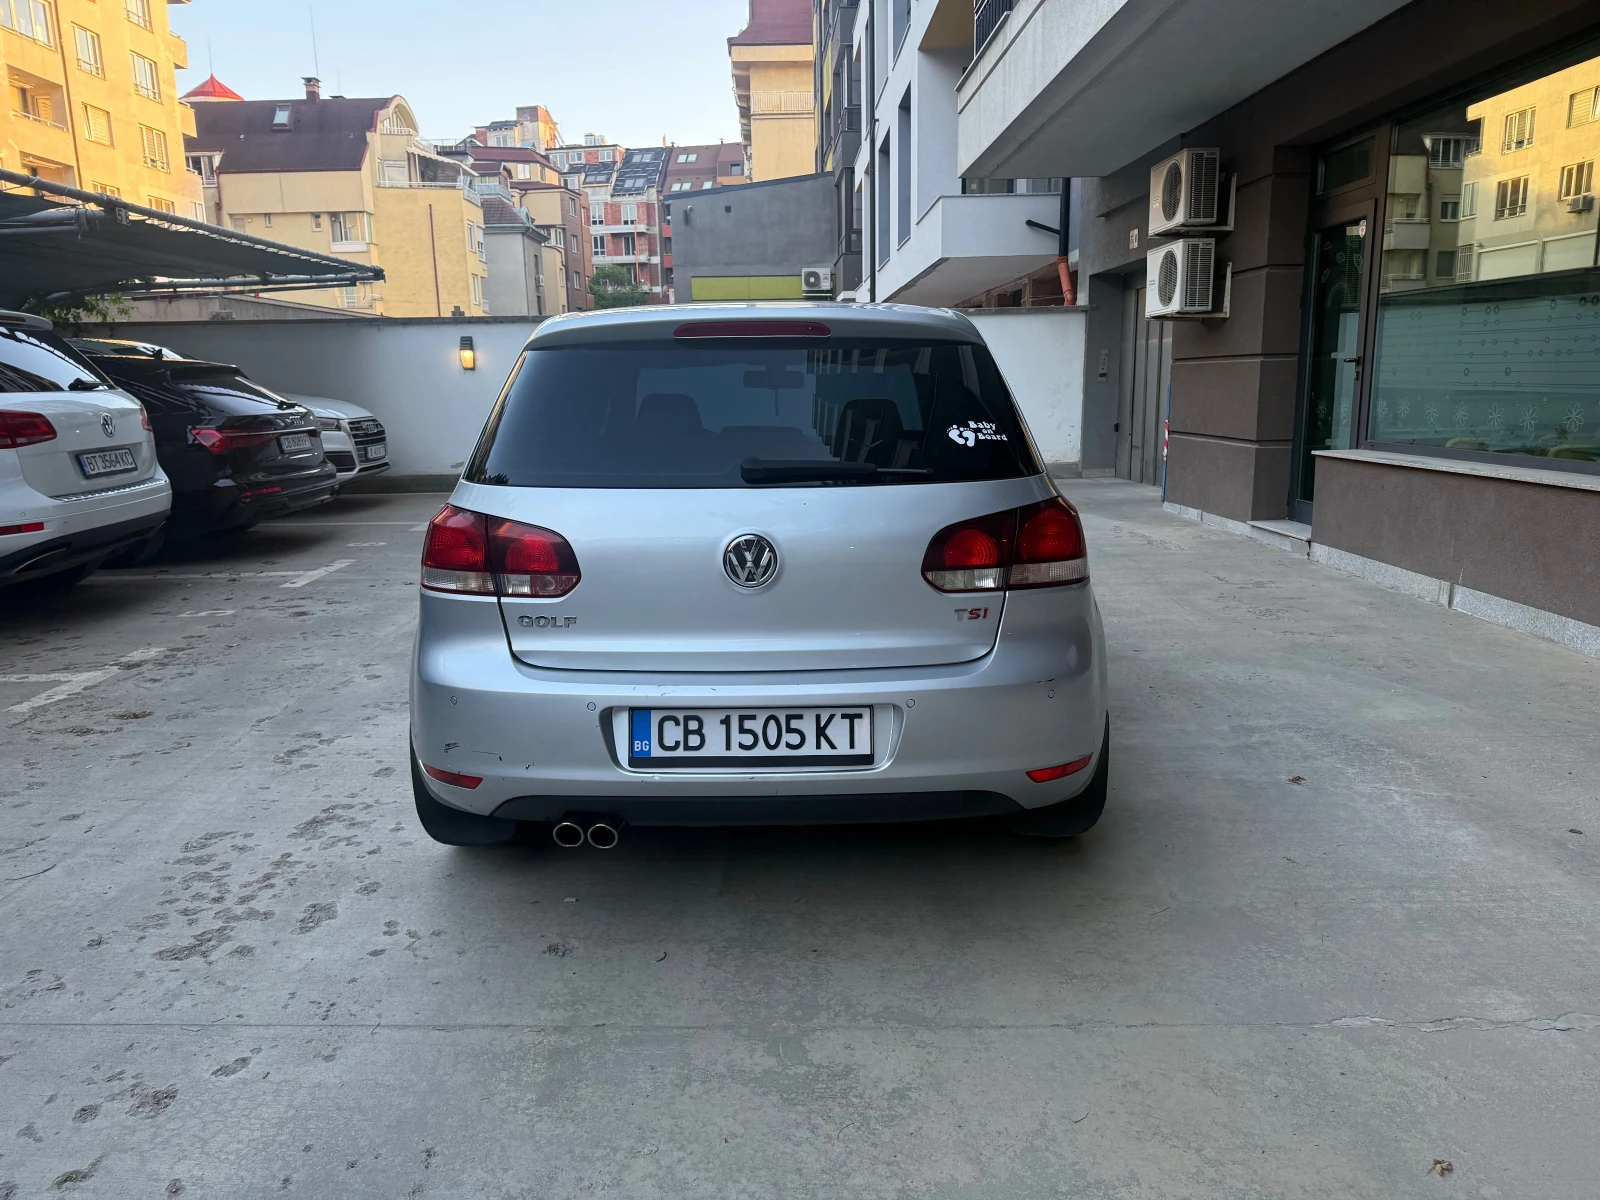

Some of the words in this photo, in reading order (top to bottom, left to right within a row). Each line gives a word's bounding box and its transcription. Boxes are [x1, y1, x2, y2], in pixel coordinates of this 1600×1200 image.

[968, 420, 996, 431] Baby
[977, 432, 1008, 441] Board
[85, 455, 100, 471] BT
[99, 452, 122, 470] 3564
[118, 451, 133, 467] KC
[517, 614, 577, 628] GOLF
[954, 607, 989, 621] TSI
[657, 714, 706, 751] CB
[719, 713, 806, 751] 1505
[815, 712, 863, 750] KT
[634, 740, 650, 752] BG
